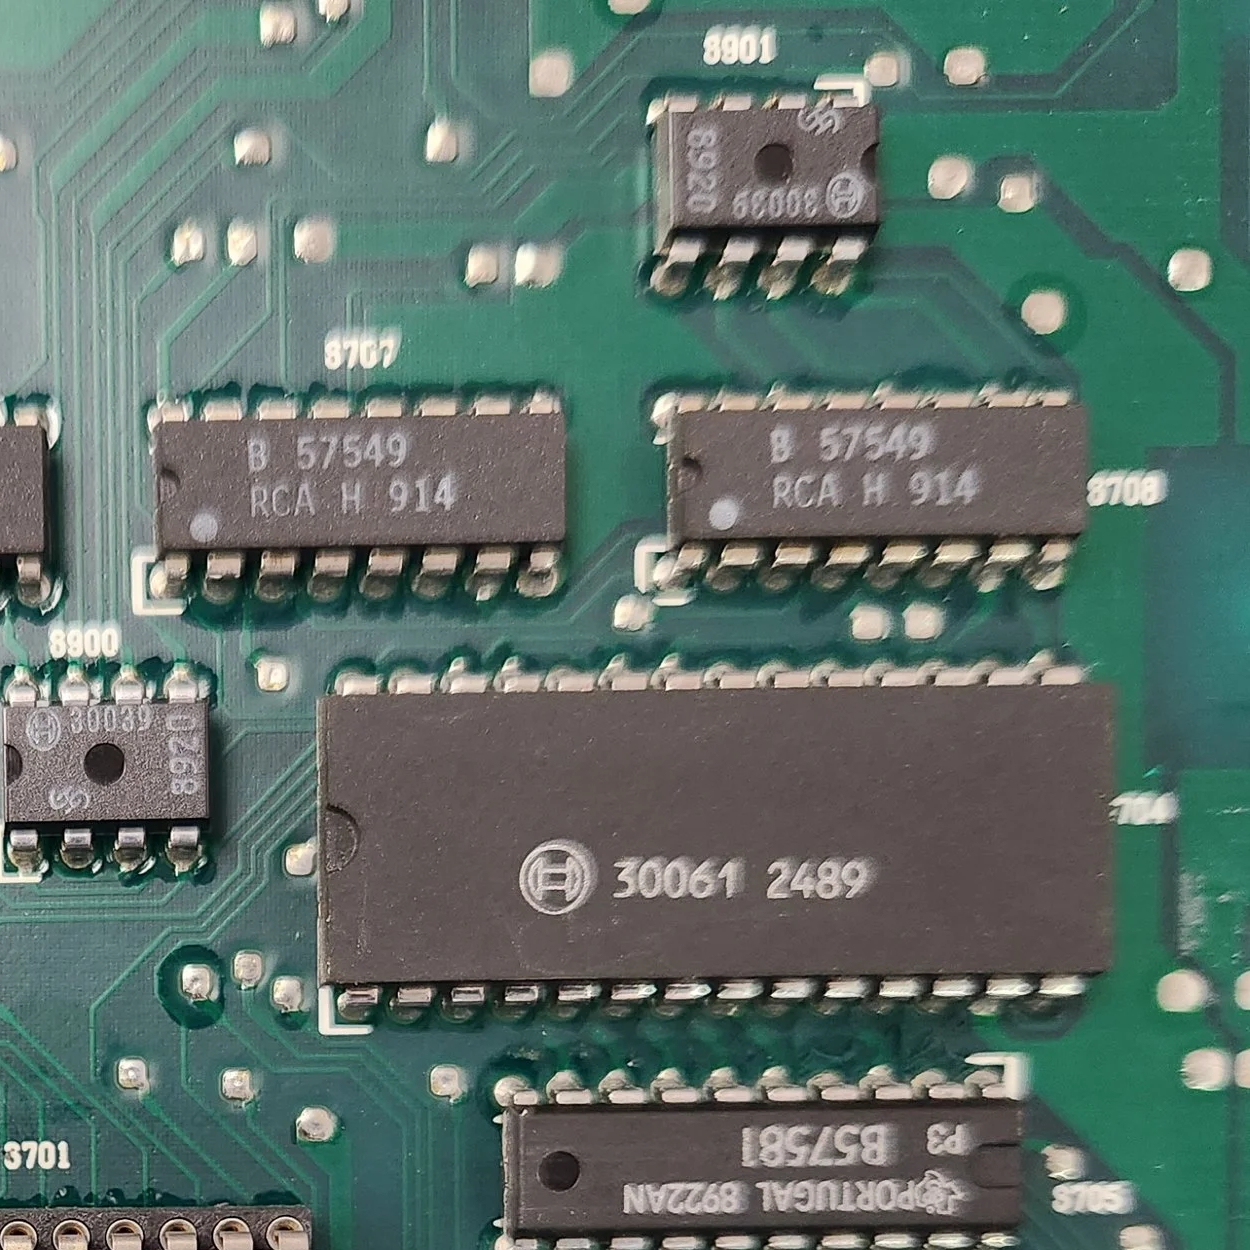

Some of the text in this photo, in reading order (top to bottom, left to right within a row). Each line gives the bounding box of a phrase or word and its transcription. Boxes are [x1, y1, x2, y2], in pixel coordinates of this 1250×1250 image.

[248, 433, 409, 471] B 57549
[769, 425, 936, 463] B 57549
[250, 477, 457, 518] RCA H 914
[772, 470, 981, 508] RCA H 914
[611, 856, 879, 900] 30061 2489
[740, 1121, 972, 1169] P3 B57581
[622, 1178, 912, 1215] PORTUGAL 8922AN
